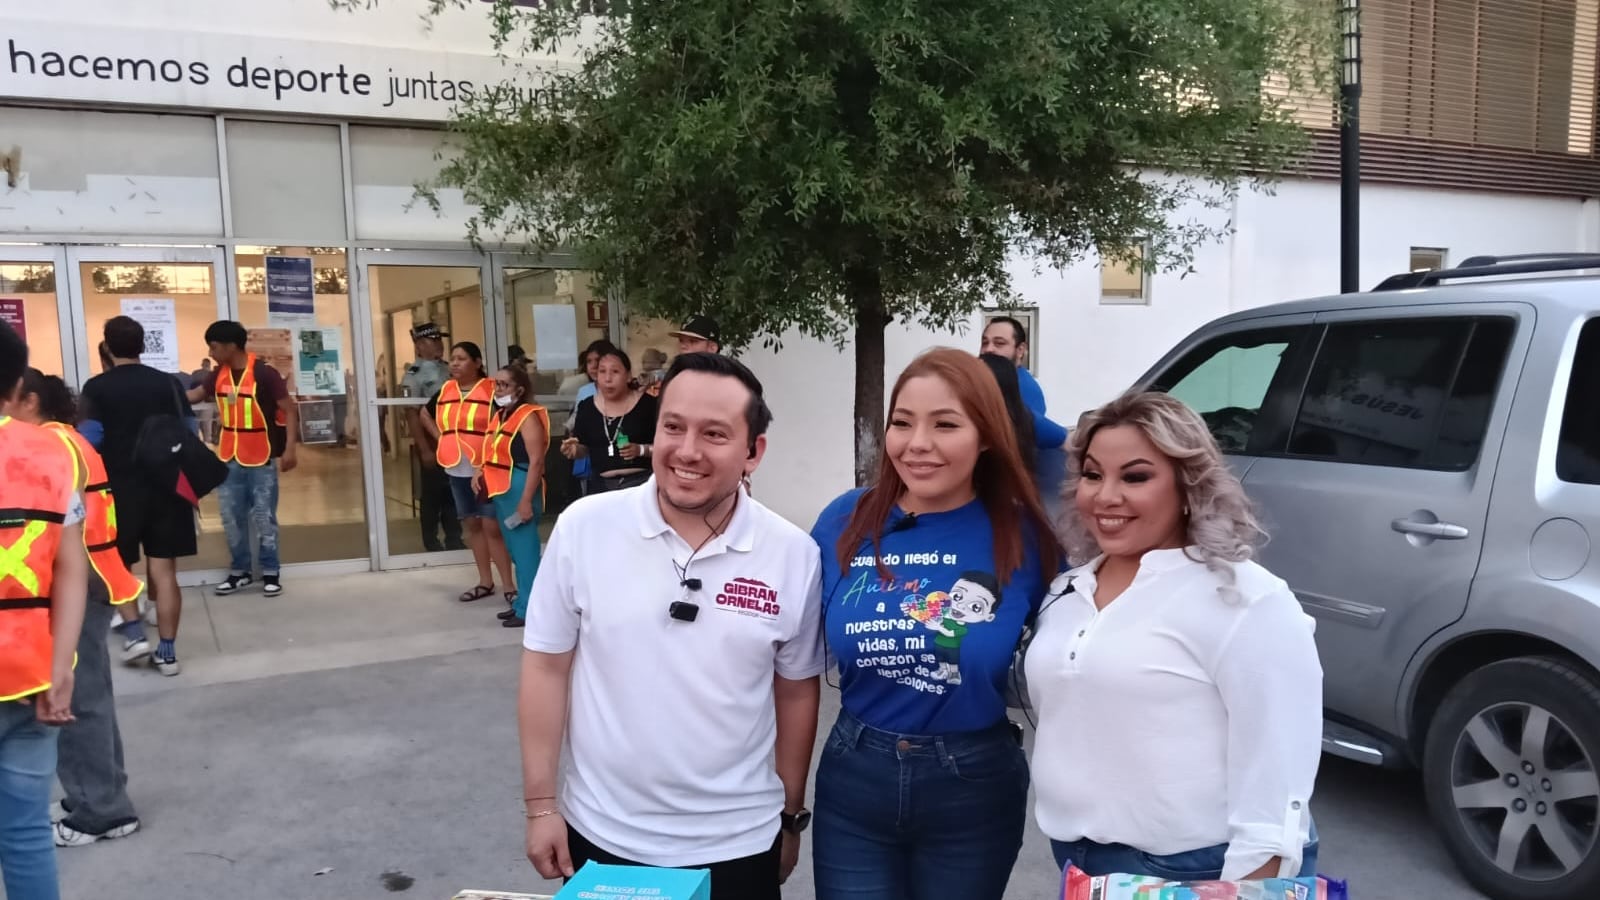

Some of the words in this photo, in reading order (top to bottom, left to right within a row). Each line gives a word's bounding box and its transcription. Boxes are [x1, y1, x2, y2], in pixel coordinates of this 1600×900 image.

[8, 38, 210, 86] hacemos
[227, 56, 372, 101] deporte
[383, 68, 475, 108] juntas
[904, 549, 939, 566] llegó
[942, 553, 957, 565] el
[724, 582, 778, 603] GIBRAN
[716, 593, 781, 615] ORNELAS
[875, 602, 886, 613] a
[845, 618, 917, 635] nuestras
[857, 637, 899, 654] vidas,
[904, 634, 926, 650] mi
[856, 654, 916, 668] corazon
[920, 653, 936, 664] se
[876, 667, 911, 679] lleno
[914, 664, 930, 678] de
